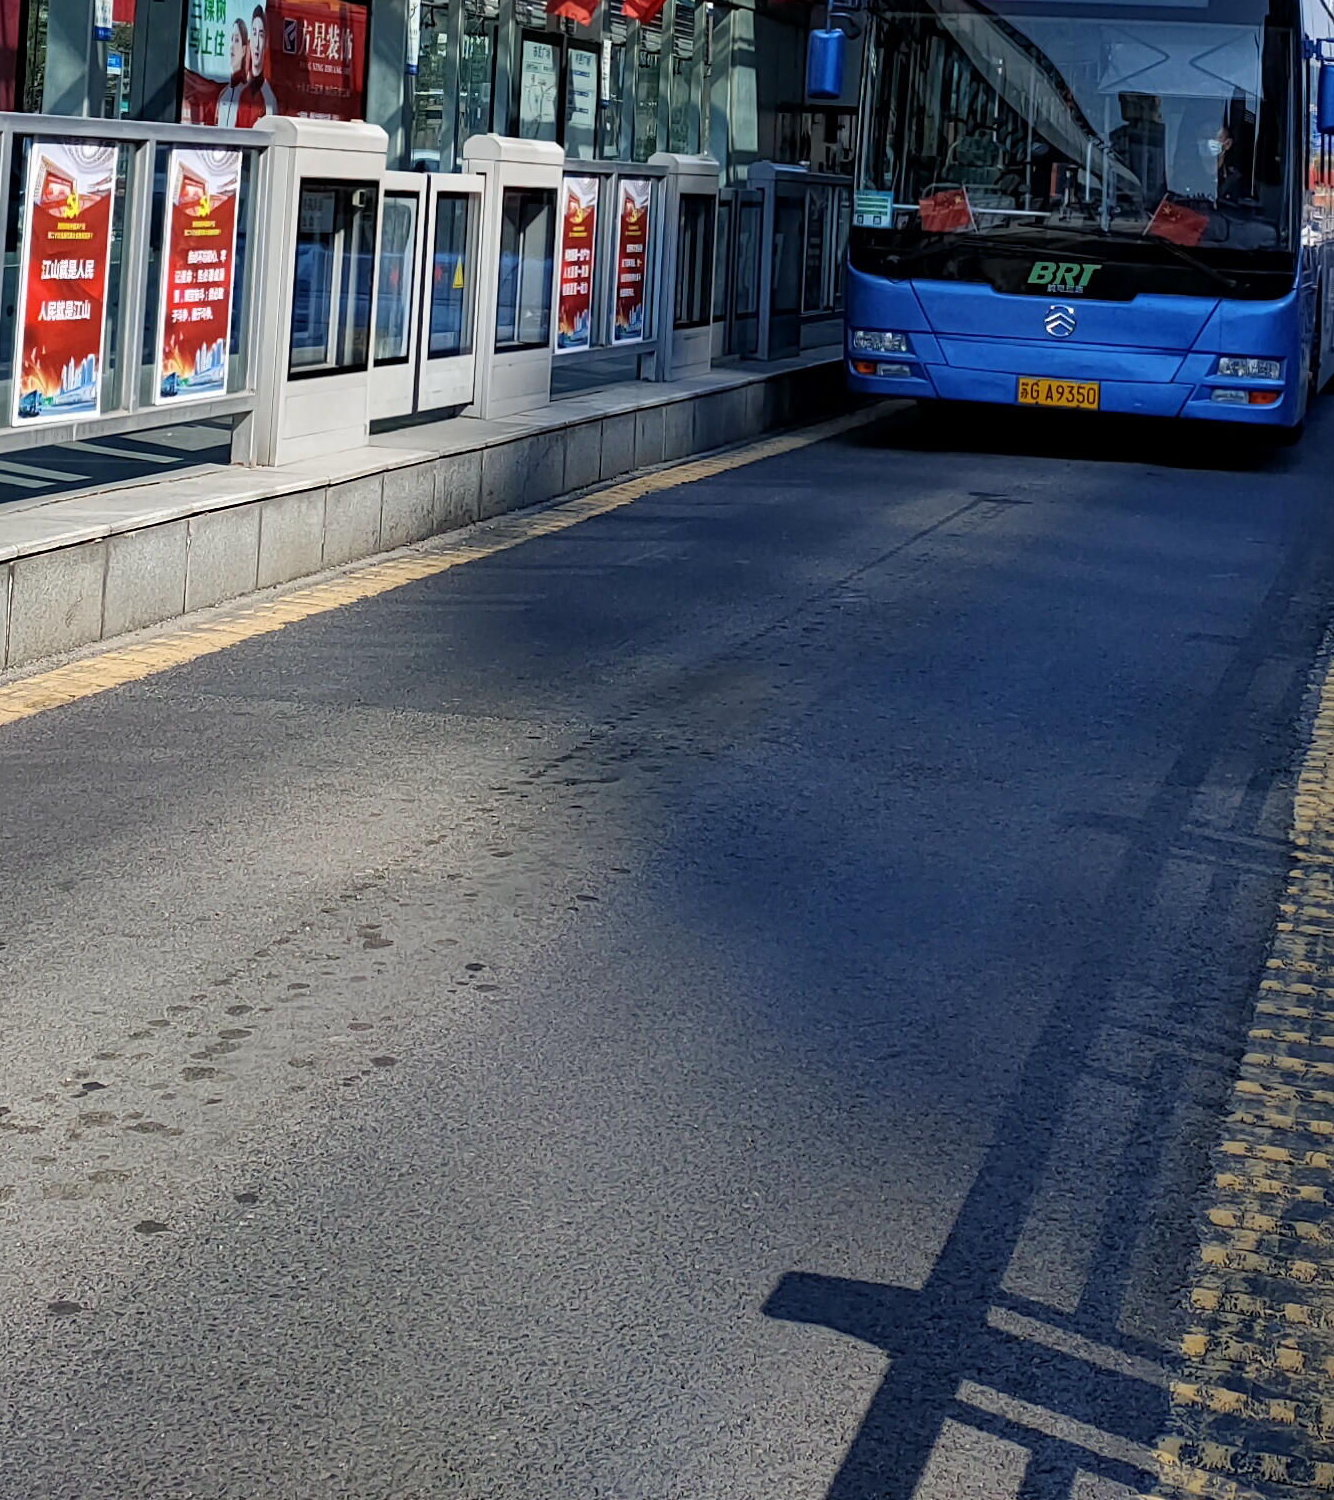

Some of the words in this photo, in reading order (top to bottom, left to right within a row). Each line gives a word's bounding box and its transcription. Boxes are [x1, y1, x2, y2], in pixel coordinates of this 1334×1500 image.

[188, 26, 225, 58] 马上住
[40, 258, 96, 281] 江山就是人民
[1027, 261, 1103, 287] BRT
[37, 299, 92, 322] 人民就是江山
